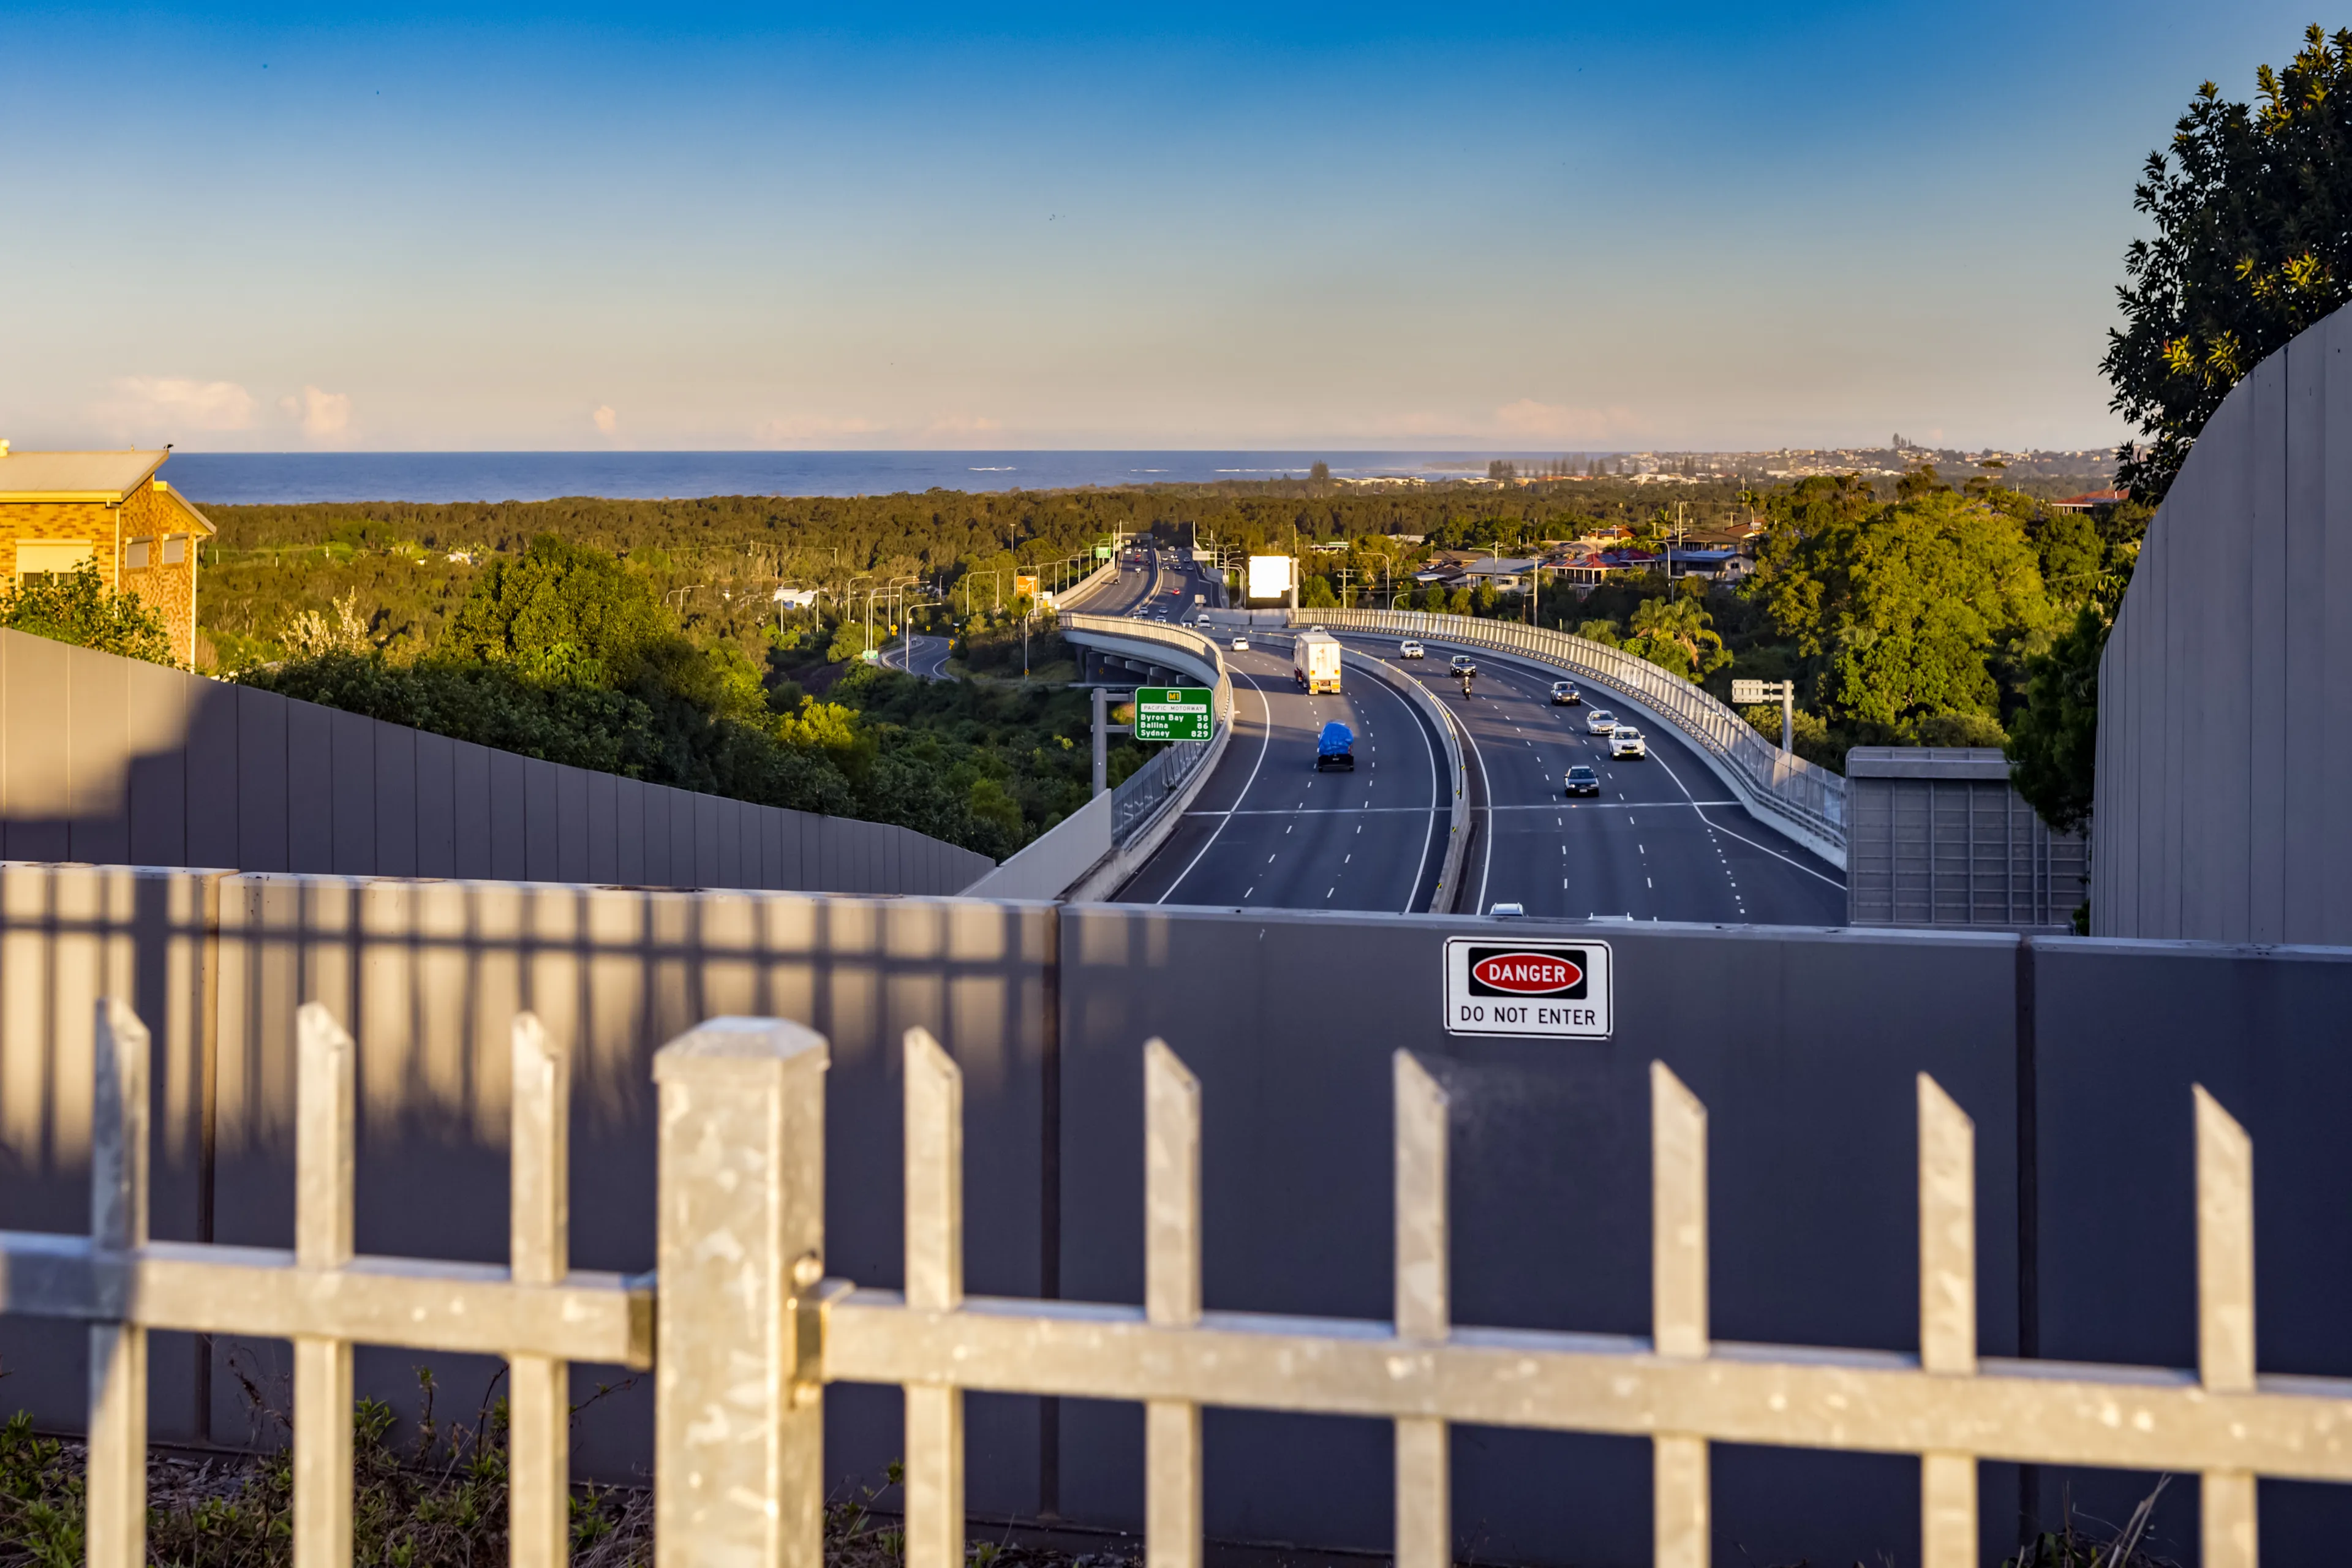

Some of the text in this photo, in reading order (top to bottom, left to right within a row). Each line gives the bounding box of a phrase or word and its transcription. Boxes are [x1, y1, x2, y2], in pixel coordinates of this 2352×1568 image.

[1140, 714, 1166, 722] Byron
[1168, 714, 1184, 723] Bay
[1140, 729, 1170, 738] Sydney
[1488, 963, 1566, 982] DANGER
[1461, 1006, 1596, 1026] DO NOT ENTER
